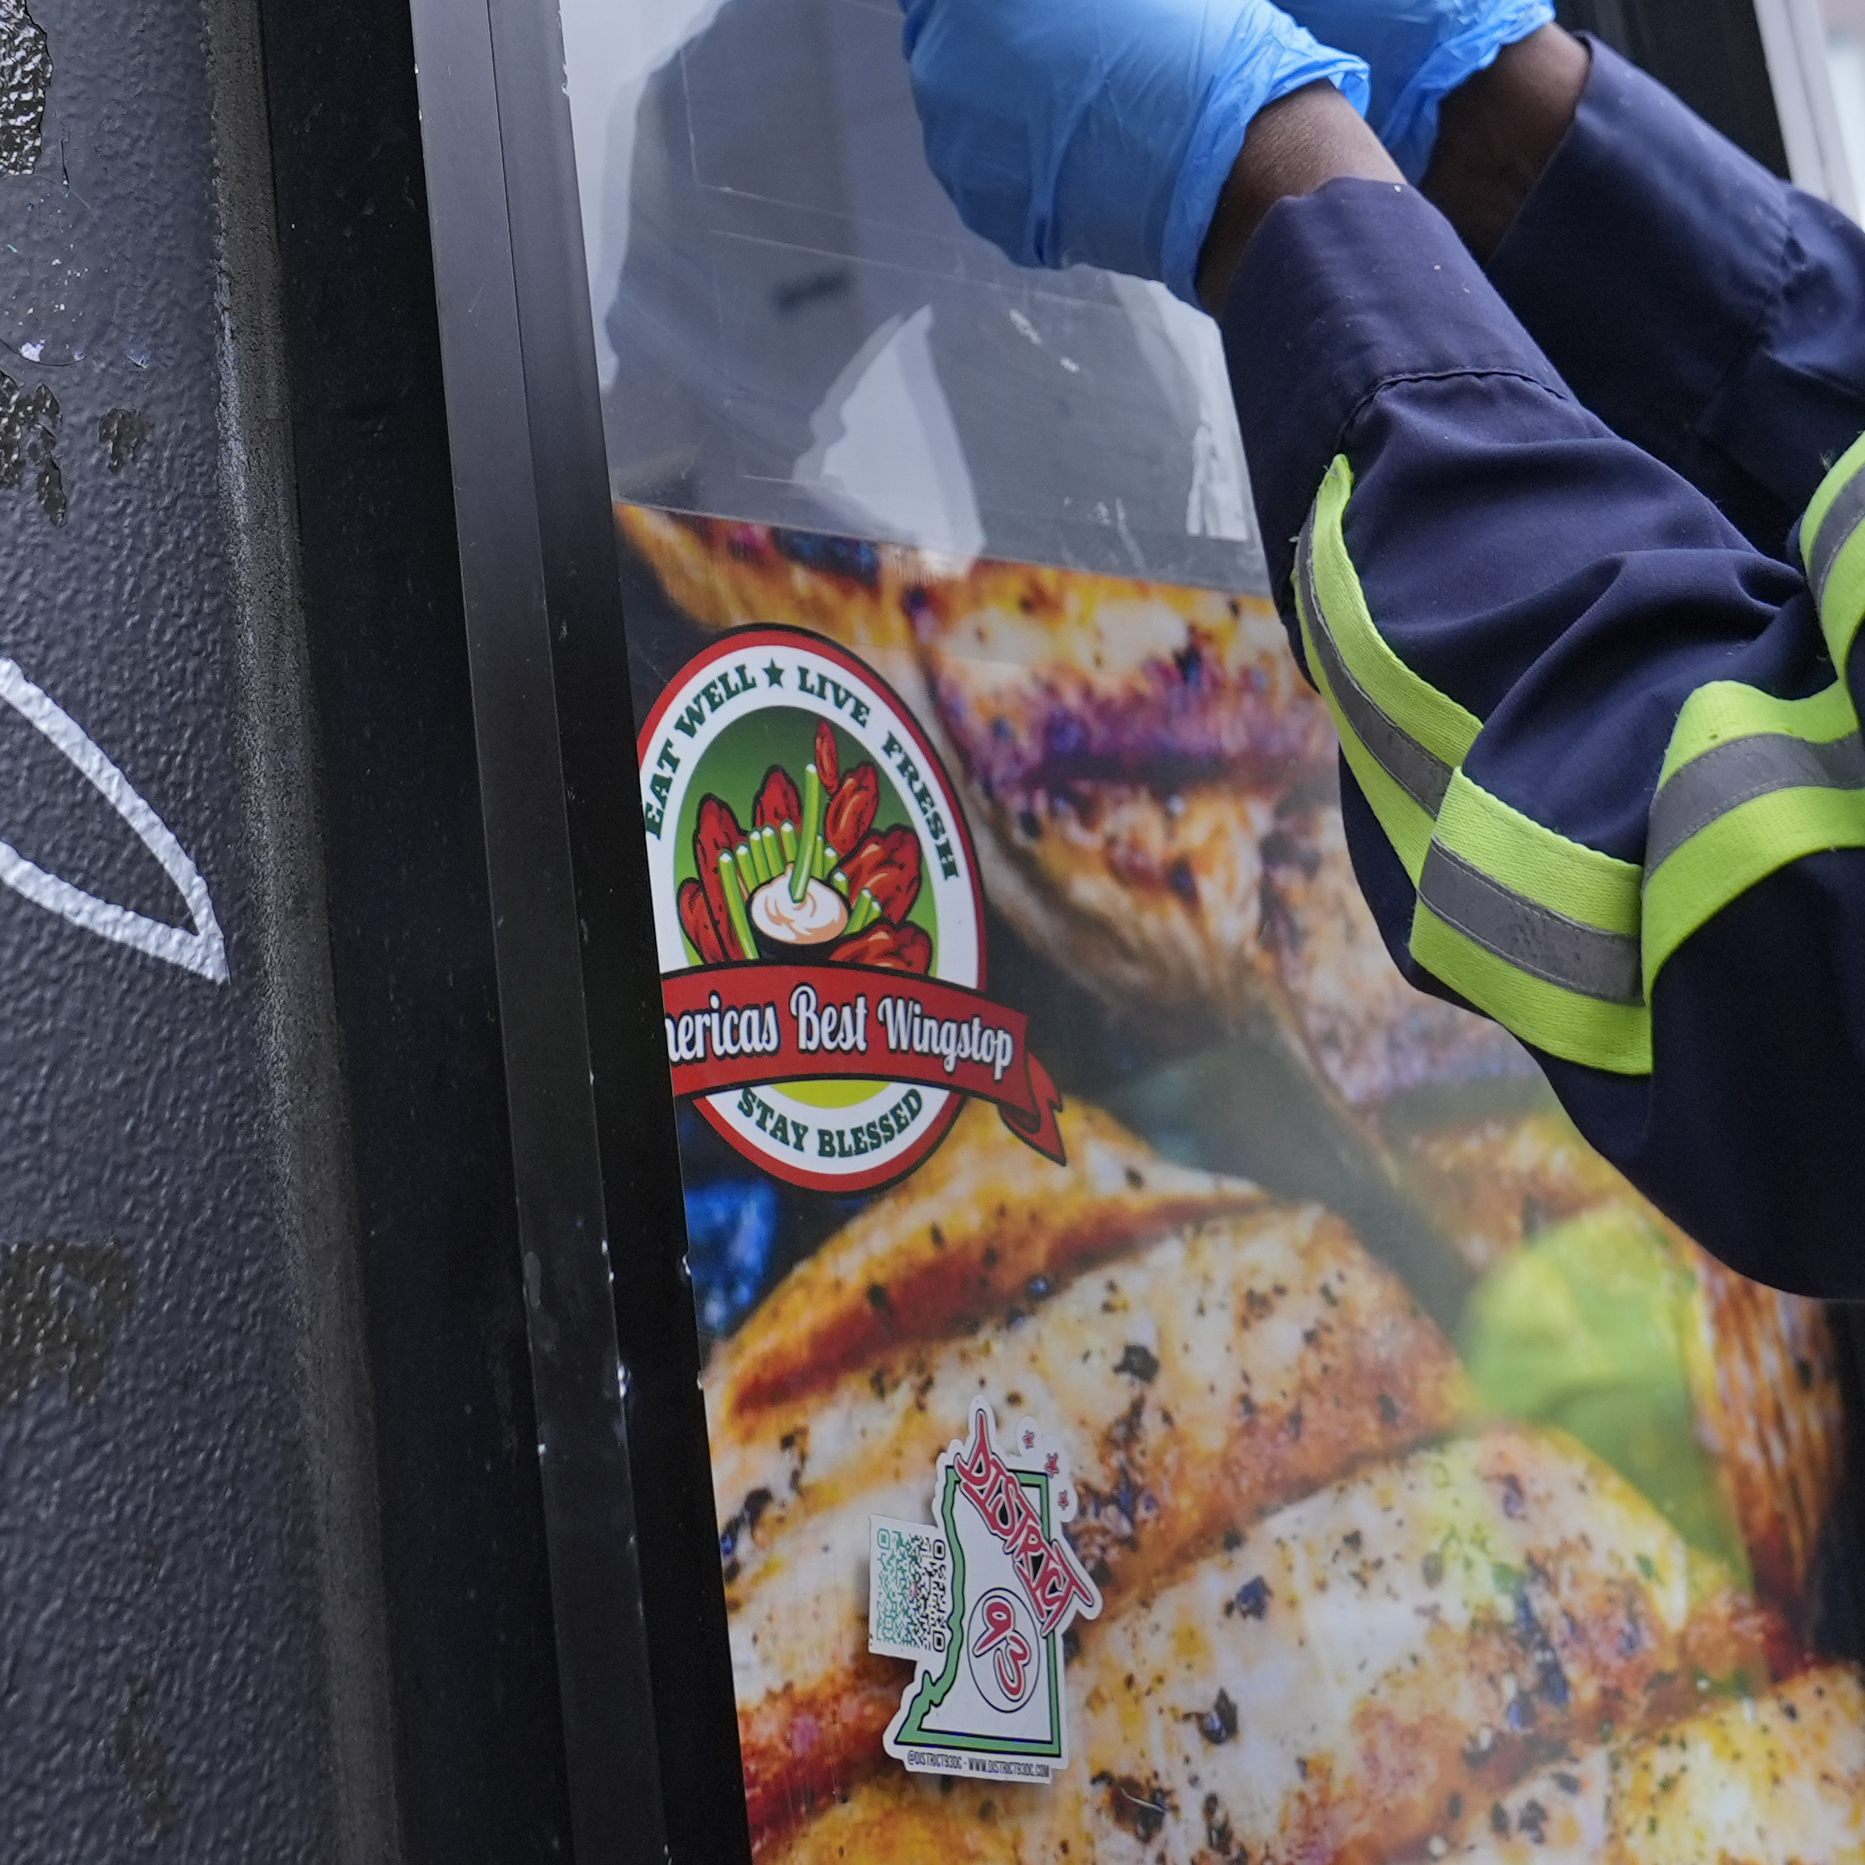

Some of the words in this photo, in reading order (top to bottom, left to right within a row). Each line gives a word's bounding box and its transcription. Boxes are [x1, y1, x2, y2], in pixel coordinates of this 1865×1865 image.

[644, 737, 682, 841] EAT
[675, 663, 757, 733] WELL
[798, 665, 871, 727] LIVE
[882, 730, 960, 881] FRESH
[791, 983, 868, 1053] Best
[878, 994, 1014, 1081] Wingstop
[738, 1087, 808, 1152] STAY
[818, 1087, 923, 1159] BLESSED
[954, 1409, 1094, 1638] DISTRICT
[973, 1599, 1030, 1698] 93
